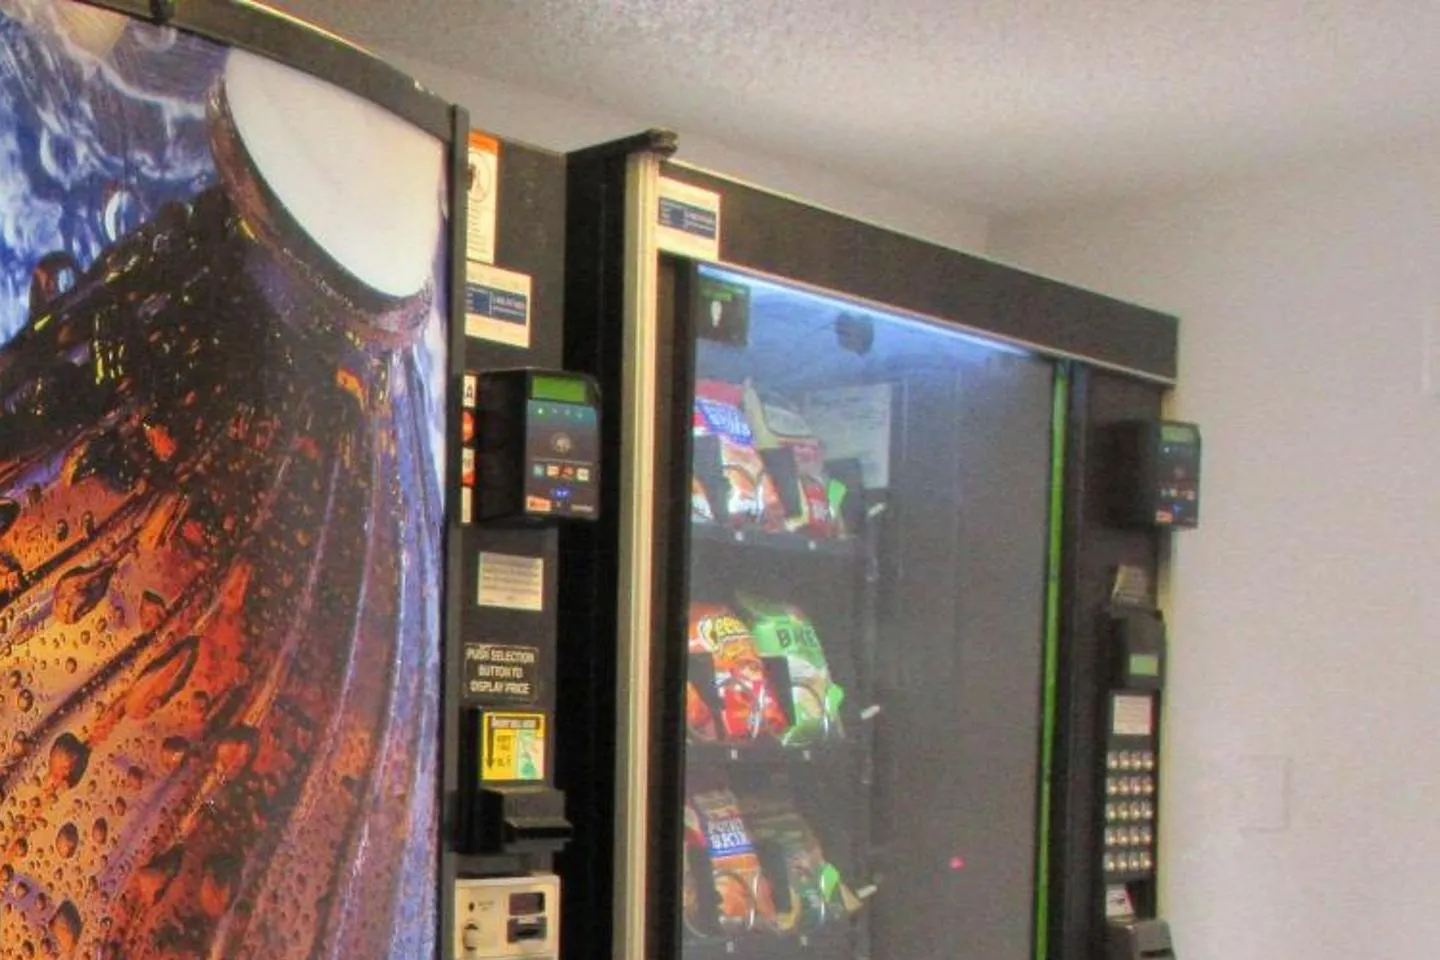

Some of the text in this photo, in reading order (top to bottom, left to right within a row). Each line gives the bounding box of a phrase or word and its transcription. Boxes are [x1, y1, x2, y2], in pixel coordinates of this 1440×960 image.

[491, 649, 535, 663] SELECTION
[470, 680, 530, 695] DISPLAY PRICE
